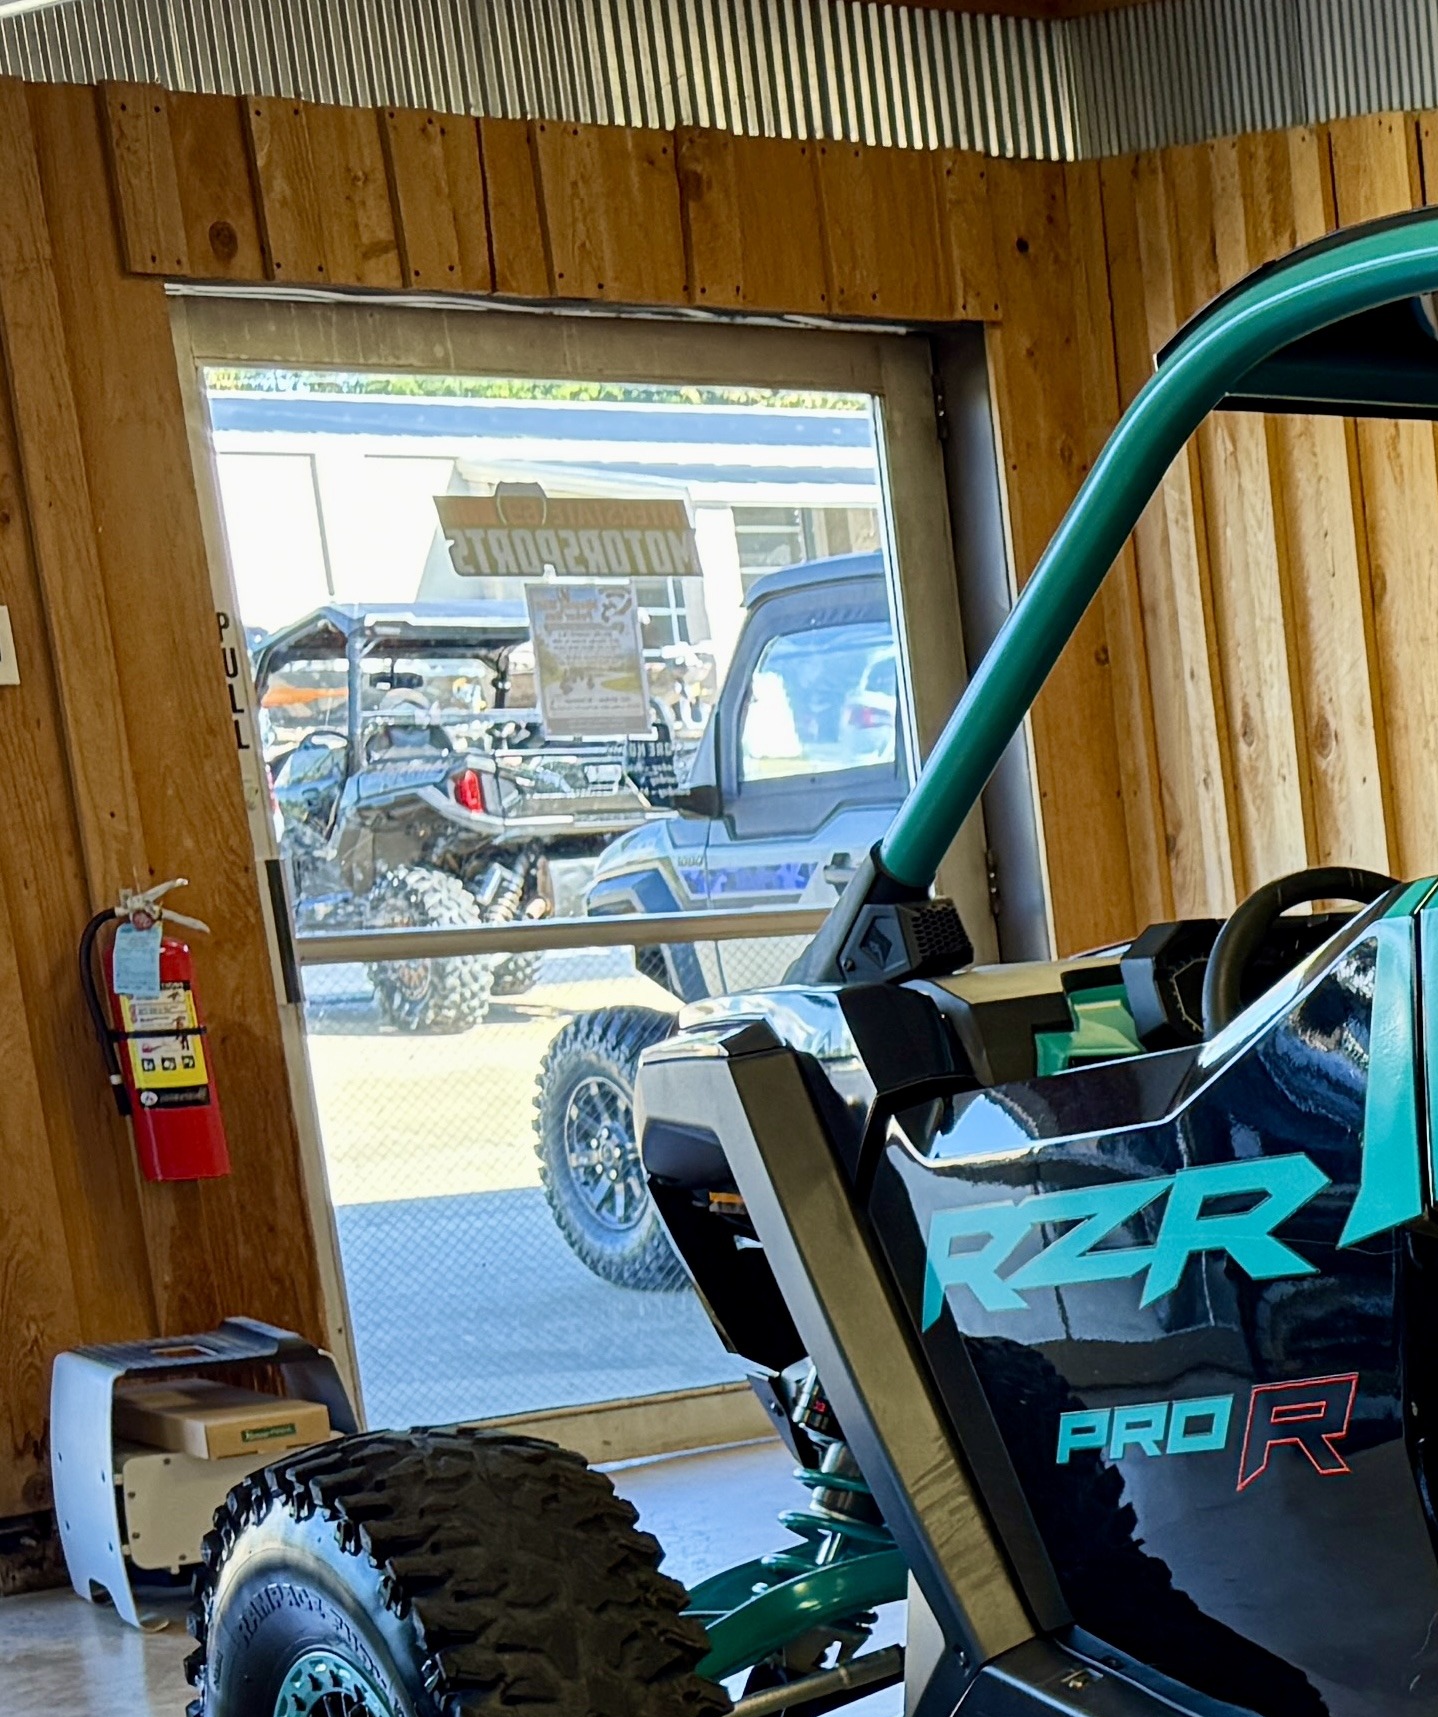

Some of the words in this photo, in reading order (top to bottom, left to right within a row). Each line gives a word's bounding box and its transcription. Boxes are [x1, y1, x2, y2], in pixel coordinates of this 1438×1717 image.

[216, 611, 250, 750] PULL
[922, 1152, 1332, 1334] RZR
[1056, 1394, 1234, 1464] PRO
[1237, 1372, 1359, 1491] R
